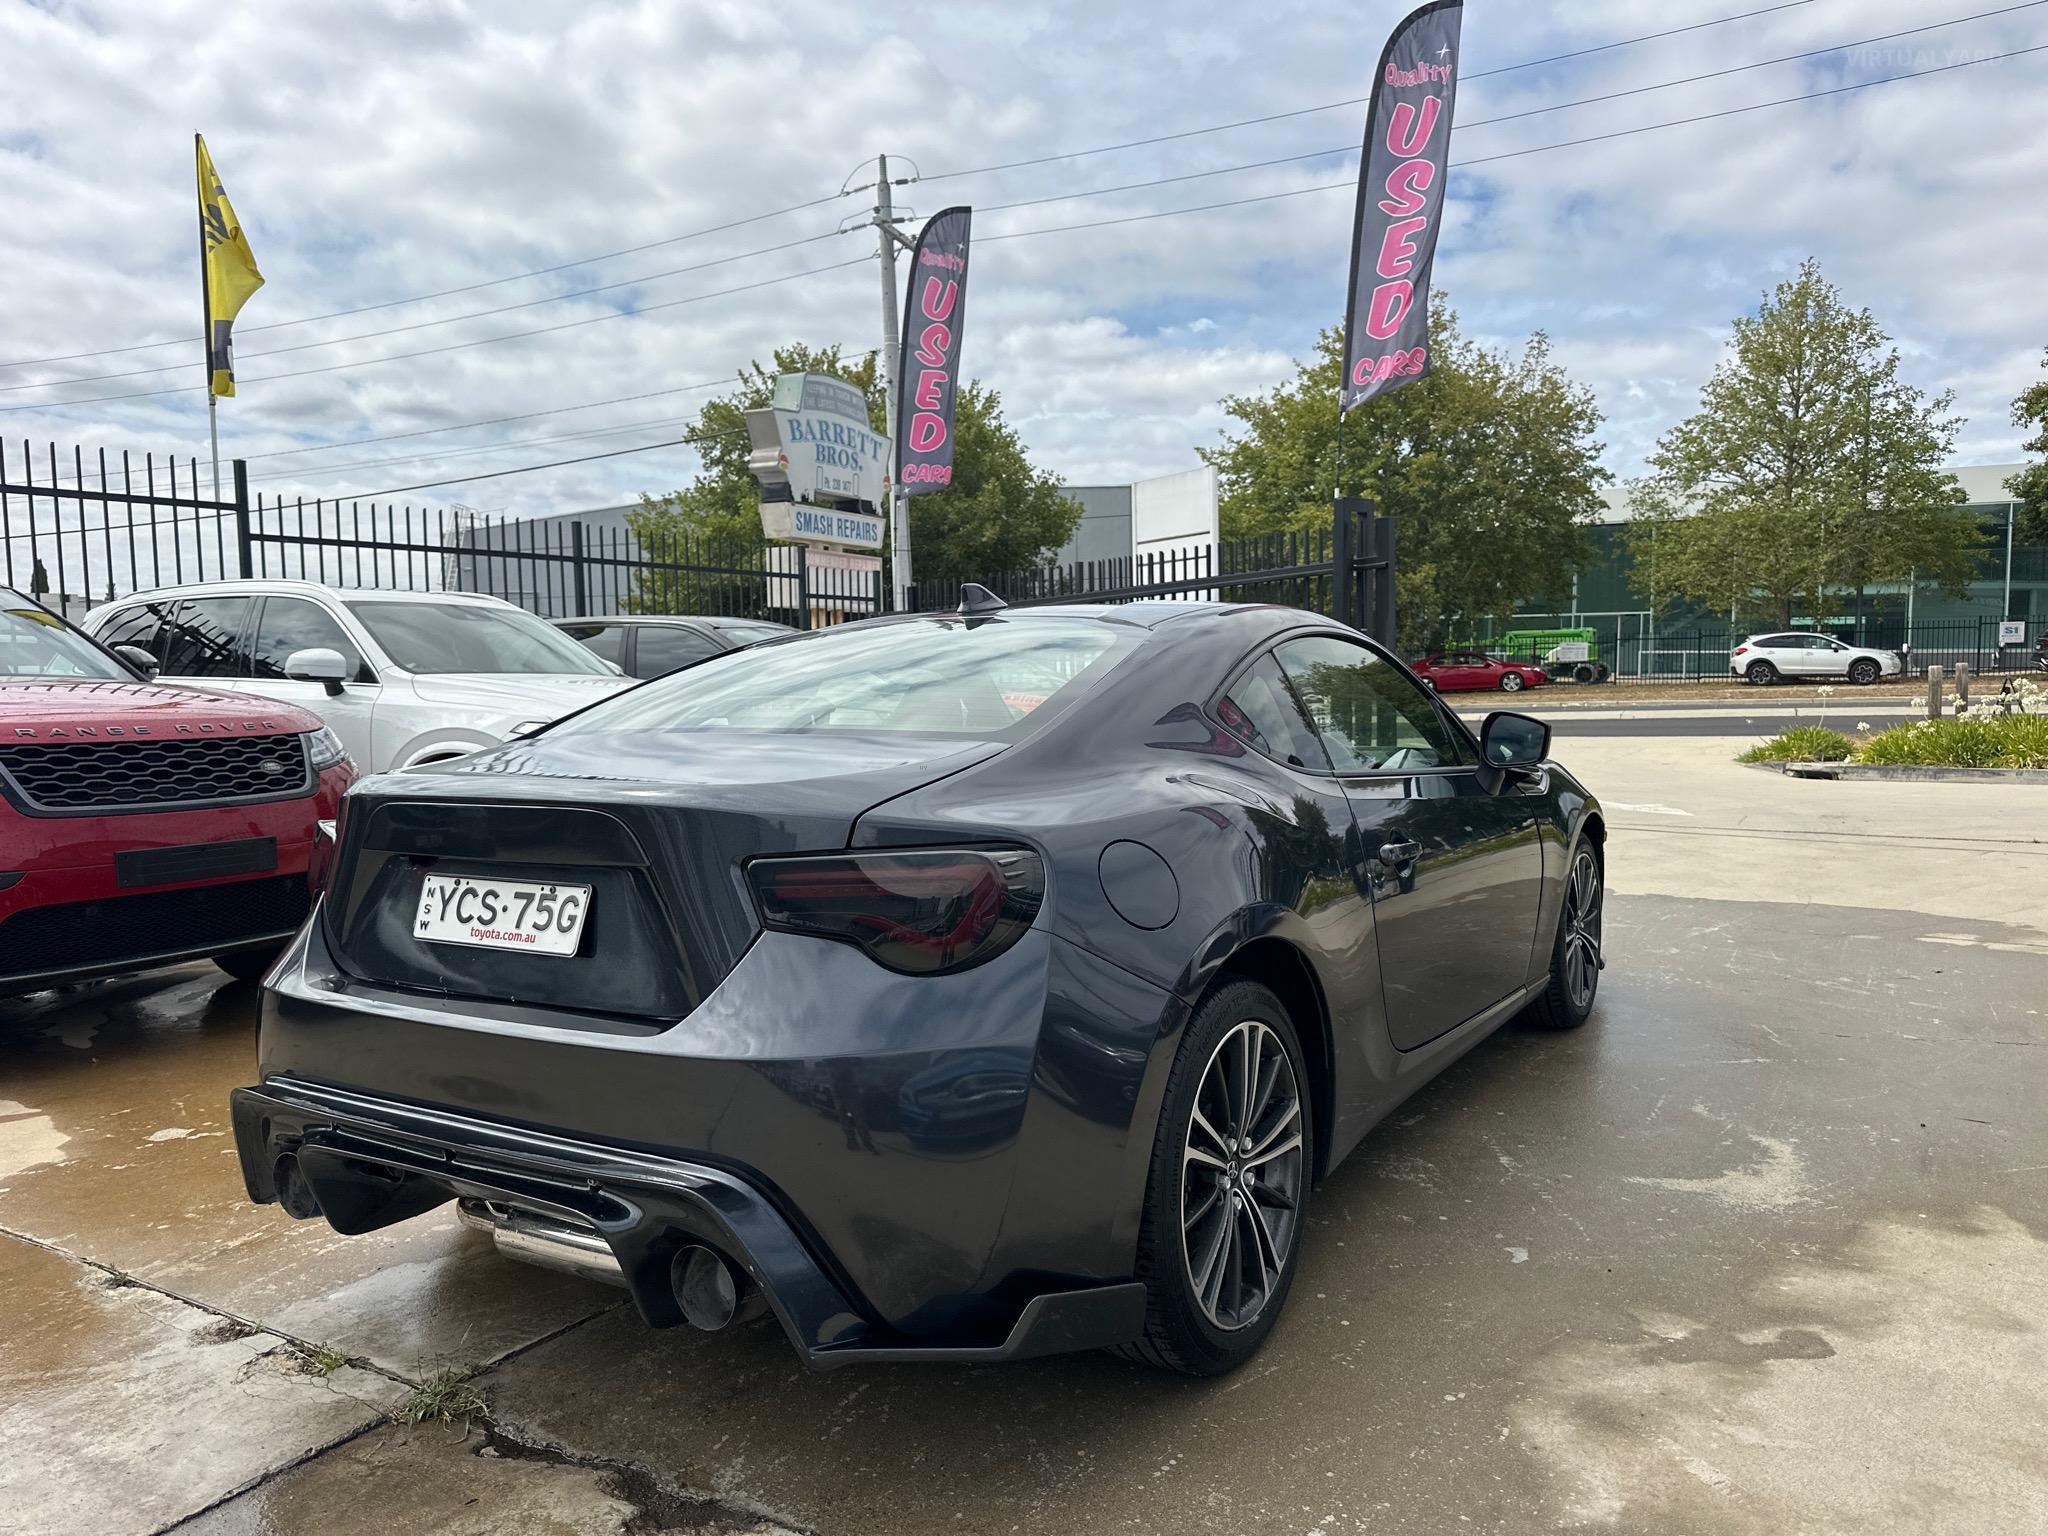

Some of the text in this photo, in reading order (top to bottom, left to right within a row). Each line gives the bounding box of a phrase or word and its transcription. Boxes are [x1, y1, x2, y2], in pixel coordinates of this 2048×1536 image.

[1384, 61, 1452, 89] Quality
[1366, 96, 1442, 340] USED
[908, 276, 958, 453] USED
[1353, 347, 1426, 386] CARS
[787, 418, 884, 462] BARRETT
[815, 443, 863, 472] BROS.
[796, 511, 878, 542] SMASH REPAIRS
[14, 720, 278, 738] RANGE ROVER
[419, 886, 436, 931] NSW
[470, 926, 538, 944] toyota.com.au
